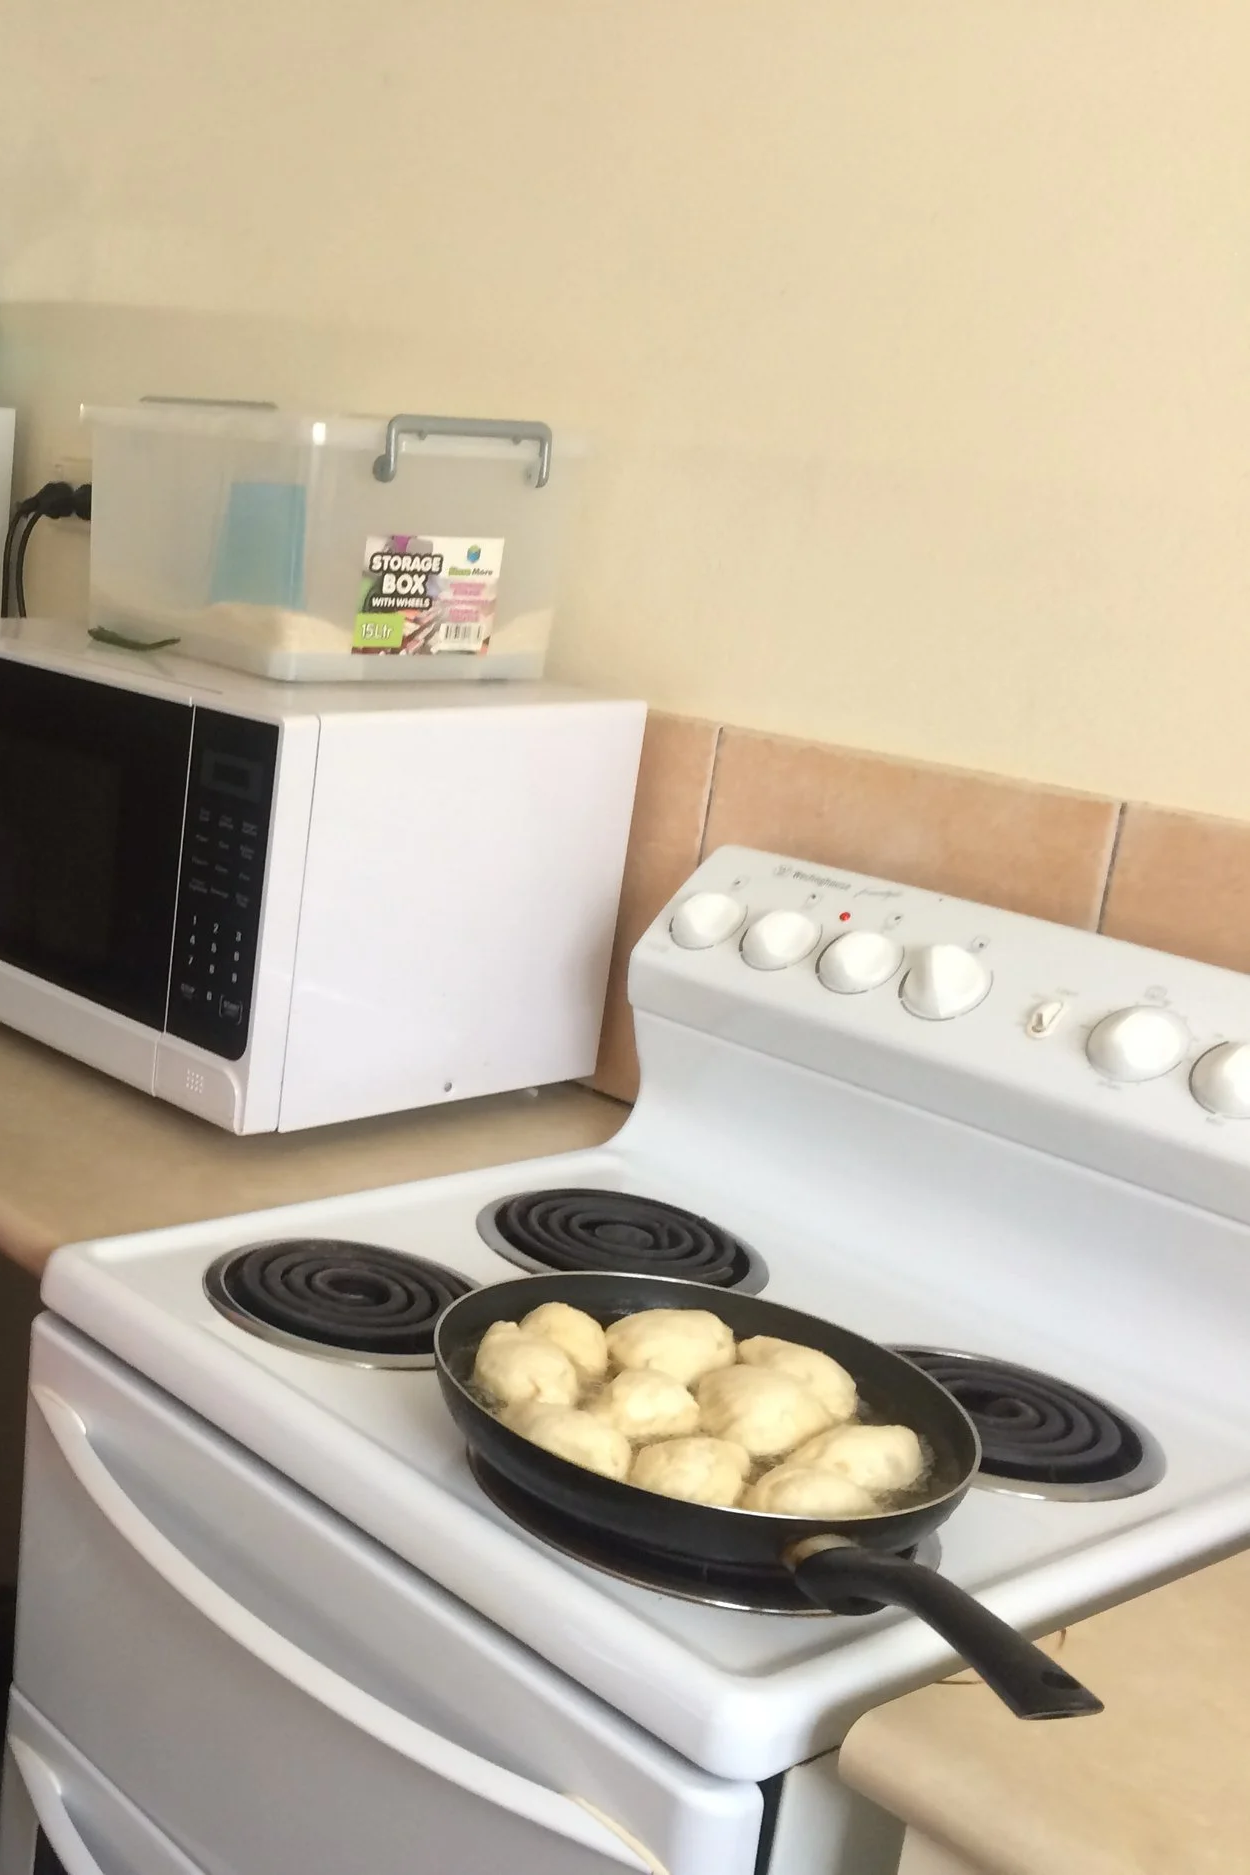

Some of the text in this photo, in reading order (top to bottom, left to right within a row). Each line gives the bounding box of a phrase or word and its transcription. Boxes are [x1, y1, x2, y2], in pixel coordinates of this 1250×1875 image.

[371, 554, 442, 573] STORAGE
[382, 572, 427, 595] BOX
[371, 596, 396, 608] WITH
[396, 597, 431, 609] WHEELS
